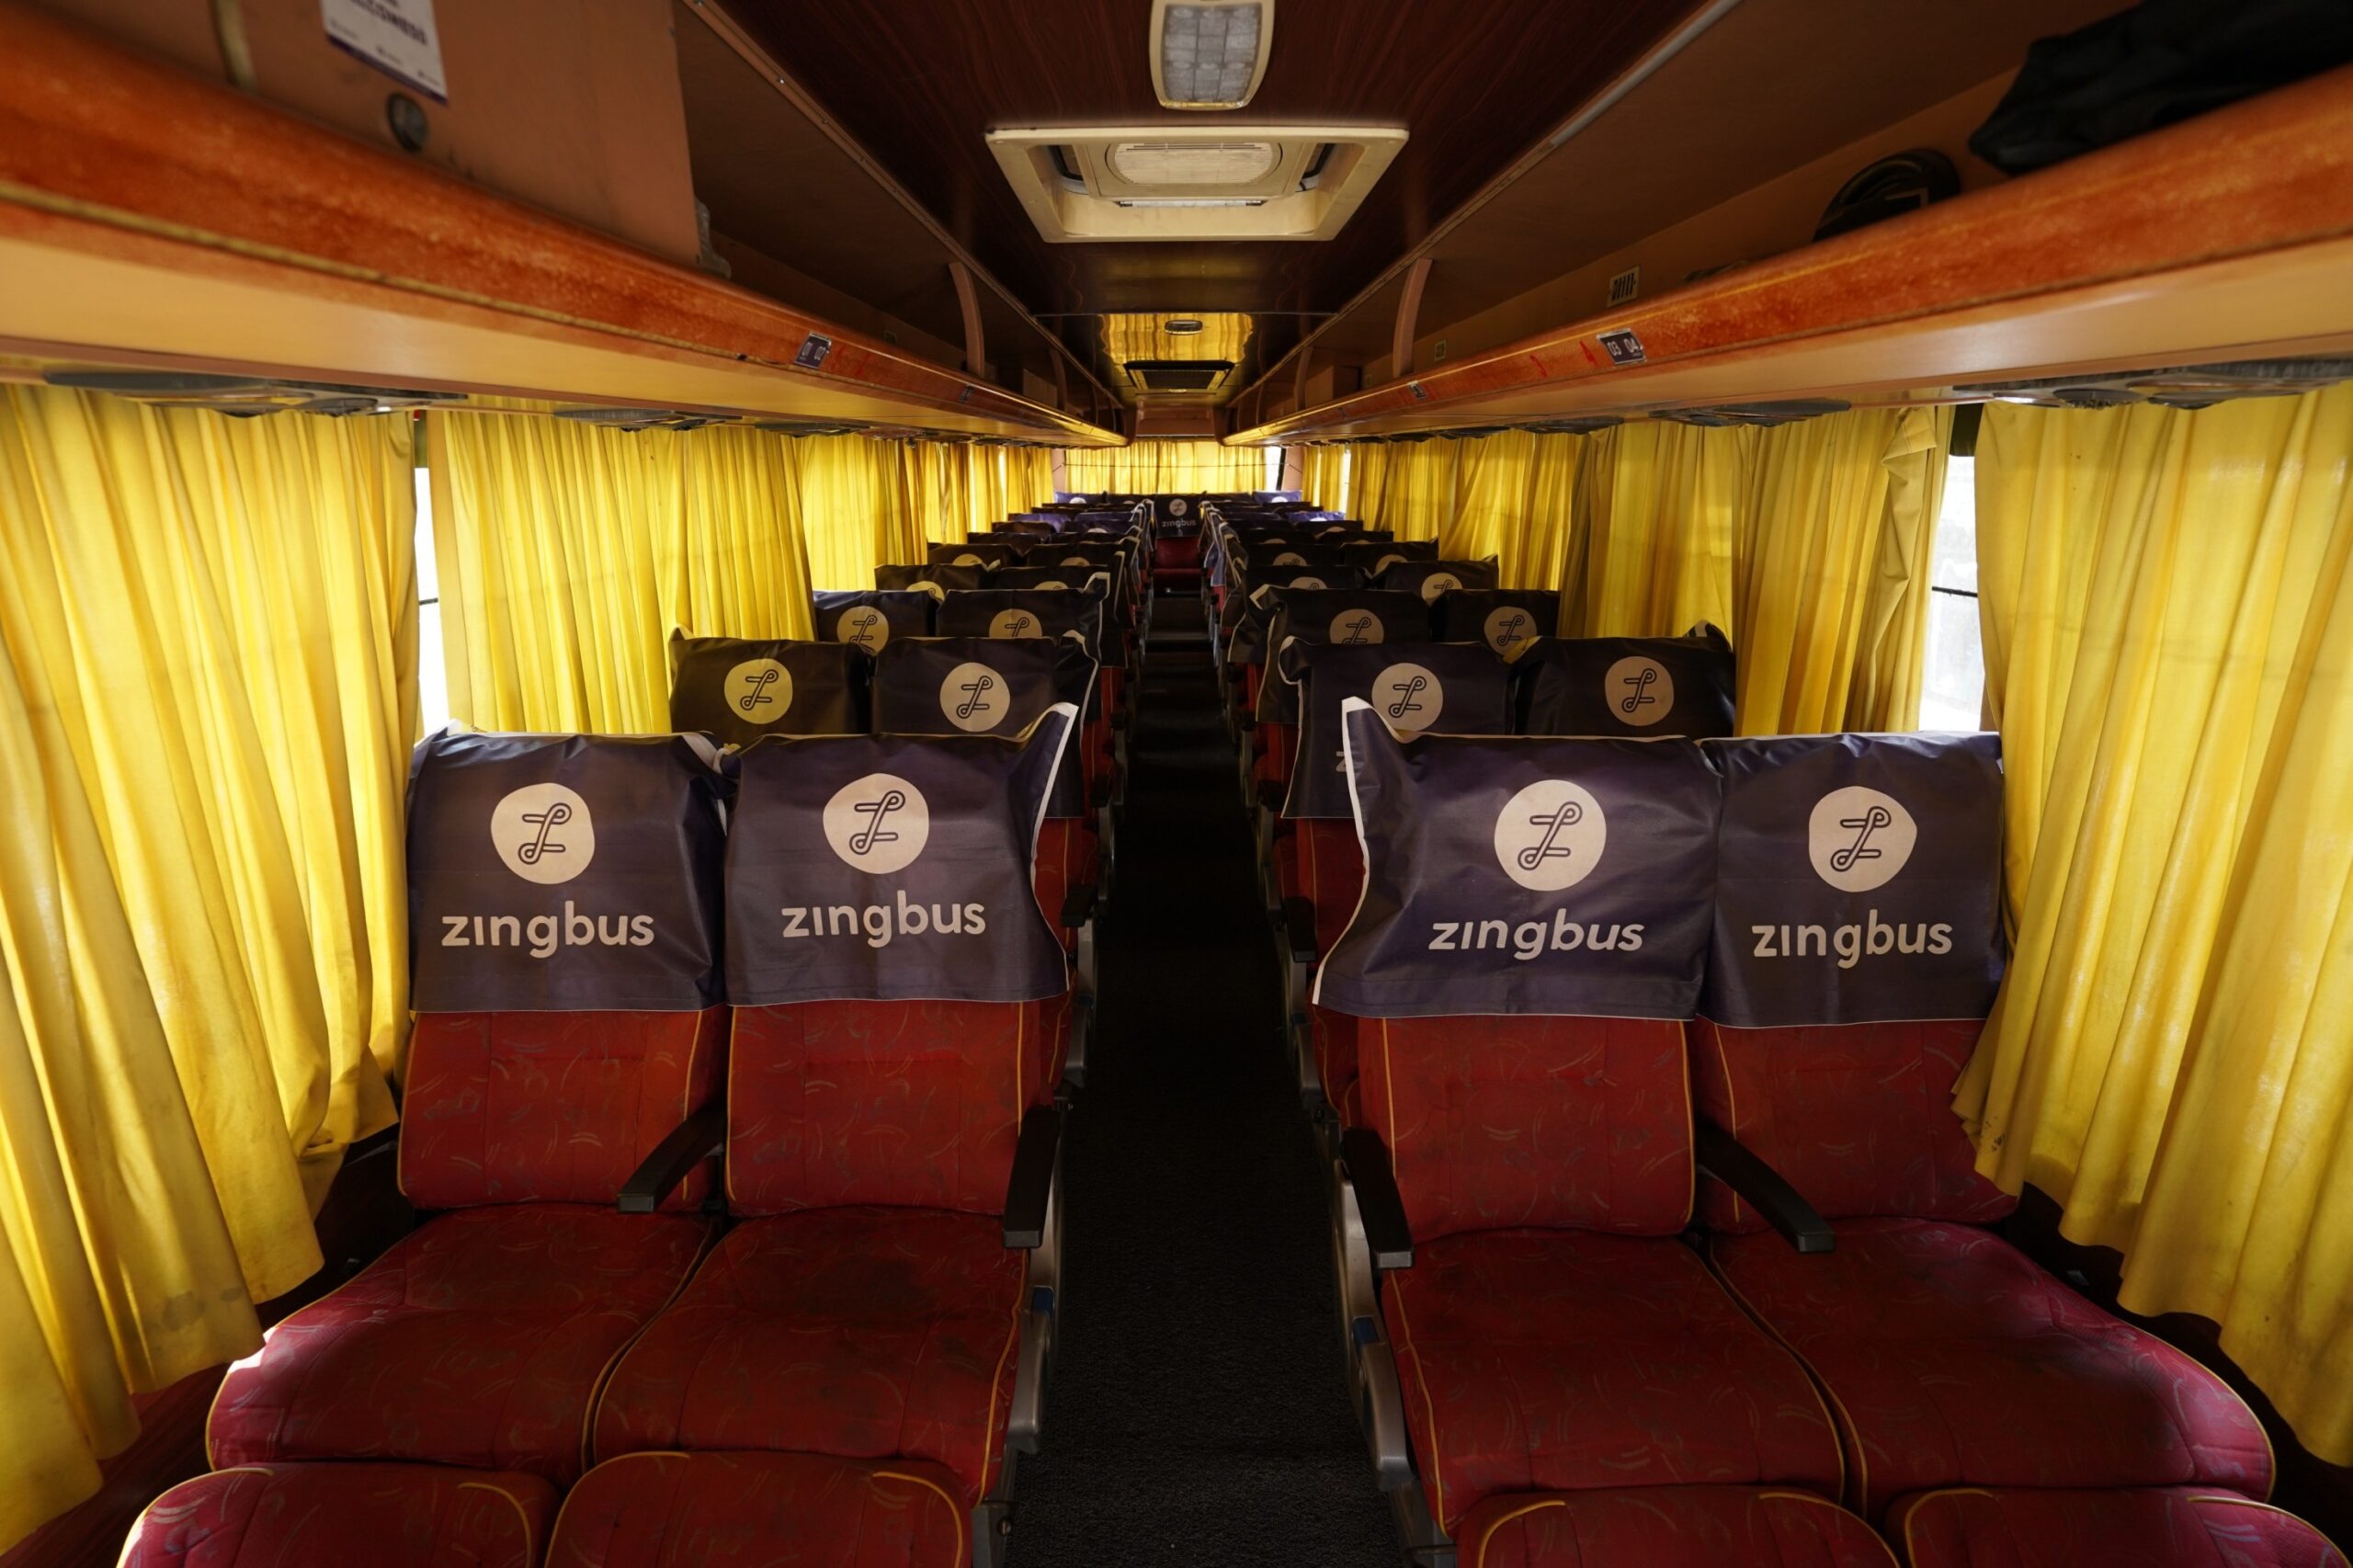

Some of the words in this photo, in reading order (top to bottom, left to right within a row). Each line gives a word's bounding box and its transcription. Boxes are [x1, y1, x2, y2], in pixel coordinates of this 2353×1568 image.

[1162, 517, 1196, 528] zingbus
[441, 900, 654, 959] zingbus
[781, 889, 986, 949] zingbus
[1428, 907, 1644, 960] zingbus
[1751, 908, 1953, 969] zingbus
